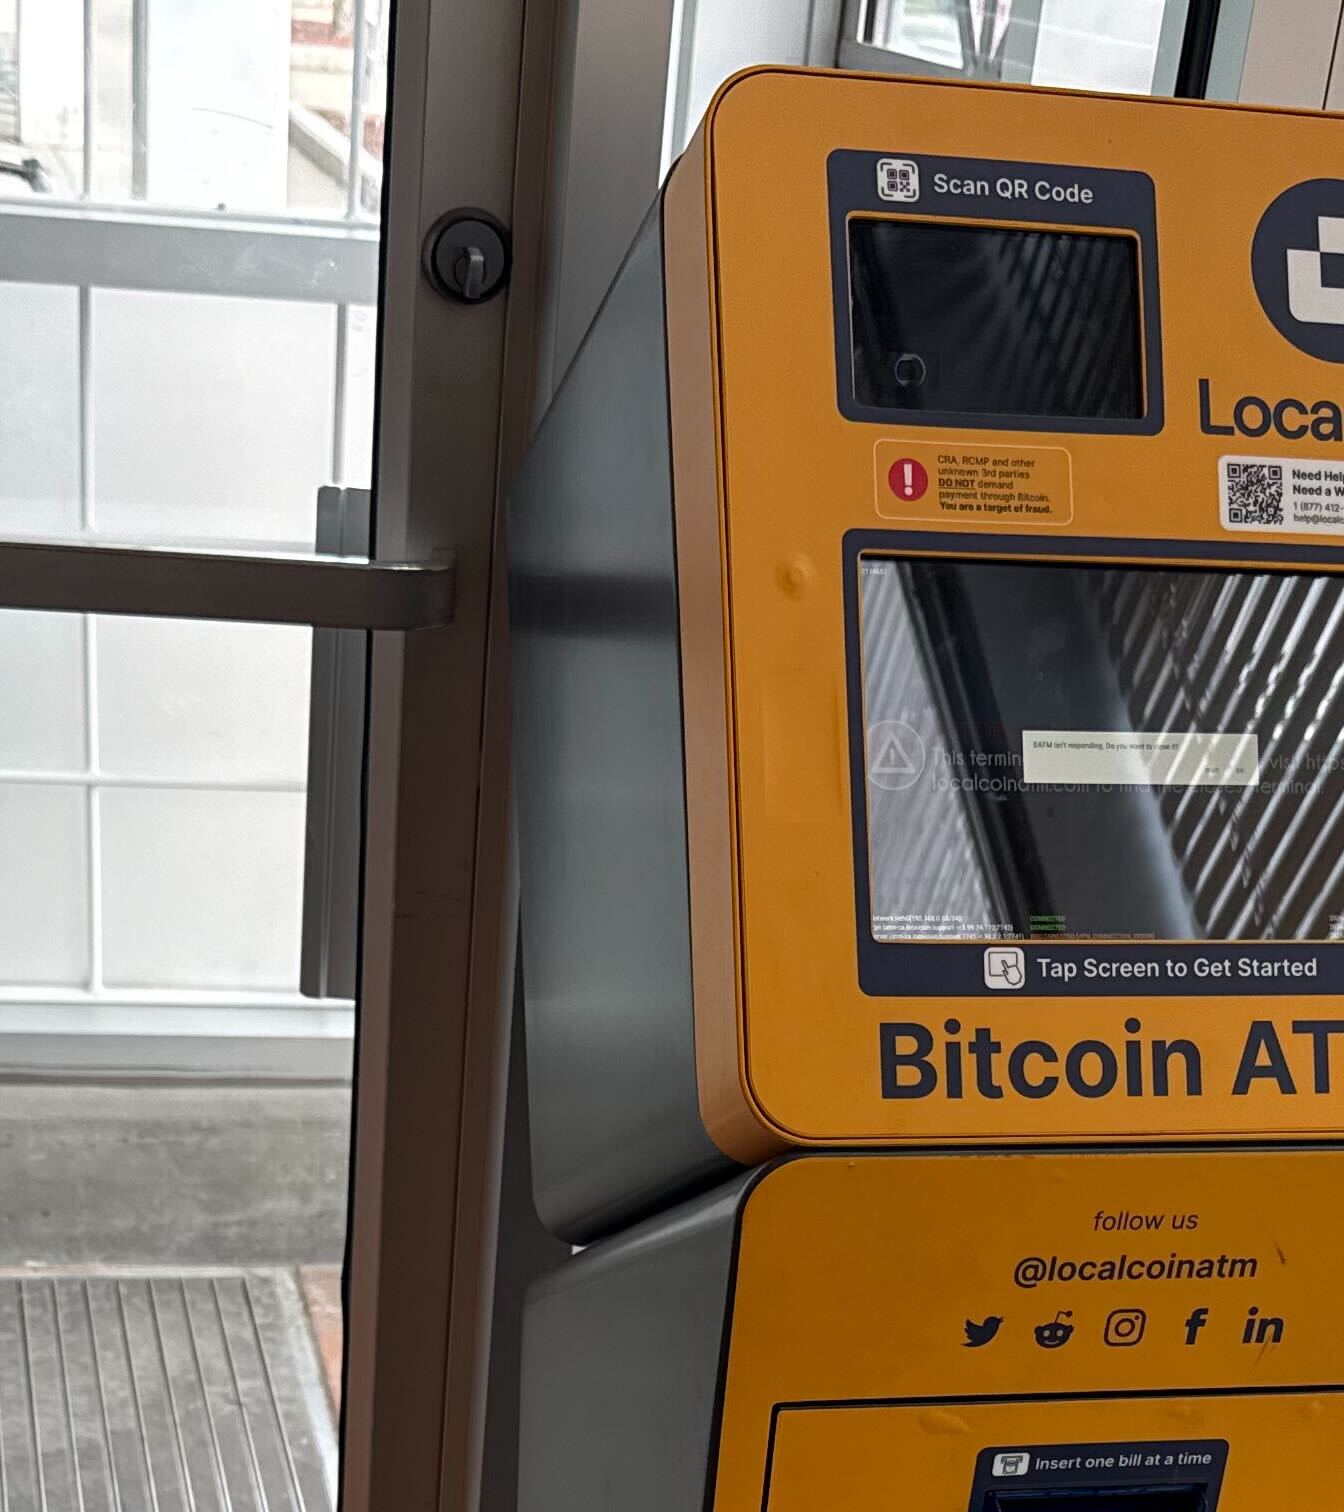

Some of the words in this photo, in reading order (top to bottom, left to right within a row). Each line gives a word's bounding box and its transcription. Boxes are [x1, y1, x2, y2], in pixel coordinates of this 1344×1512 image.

[933, 173, 989, 196] Scan
[996, 177, 1029, 199] QR
[1034, 181, 1094, 204] Code
[938, 455, 959, 467] CRA,
[962, 456, 989, 466] RCMP
[992, 457, 1009, 467] and
[1011, 458, 1035, 468] other
[938, 467, 979, 477] unknown
[982, 468, 996, 478] 3rd
[999, 469, 1030, 480] parties
[1292, 469, 1321, 481] Need
[938, 478, 953, 488] DO
[955, 479, 976, 489] NOT
[977, 480, 1014, 489] demand
[939, 491, 978, 502] payment
[980, 491, 1016, 503] through
[1292, 485, 1322, 496] Need
[1324, 488, 1331, 496] a
[939, 501, 956, 511] You
[958, 503, 974, 511] are
[976, 504, 982, 512] a
[983, 503, 1012, 514] target
[1013, 503, 1023, 513] of
[1025, 504, 1053, 514] fraud.
[1300, 502, 1323, 513] (877)
[1036, 958, 1077, 982] Tap
[1083, 958, 1159, 979] Screen
[1166, 960, 1187, 978] to
[1193, 958, 1232, 978] Get
[1237, 957, 1318, 977] Started
[878, 1017, 1202, 1099] Bitcoin
[1093, 1210, 1165, 1232] follow
[1171, 1213, 1198, 1231] us
[1013, 1252, 1258, 1289] @localcoinatm
[1035, 1456, 1082, 1471] Insert
[1085, 1457, 1114, 1469] one
[1118, 1454, 1141, 1468] bill
[1144, 1454, 1160, 1467] at
[1164, 1456, 1173, 1466] a
[1177, 1451, 1212, 1465] time
